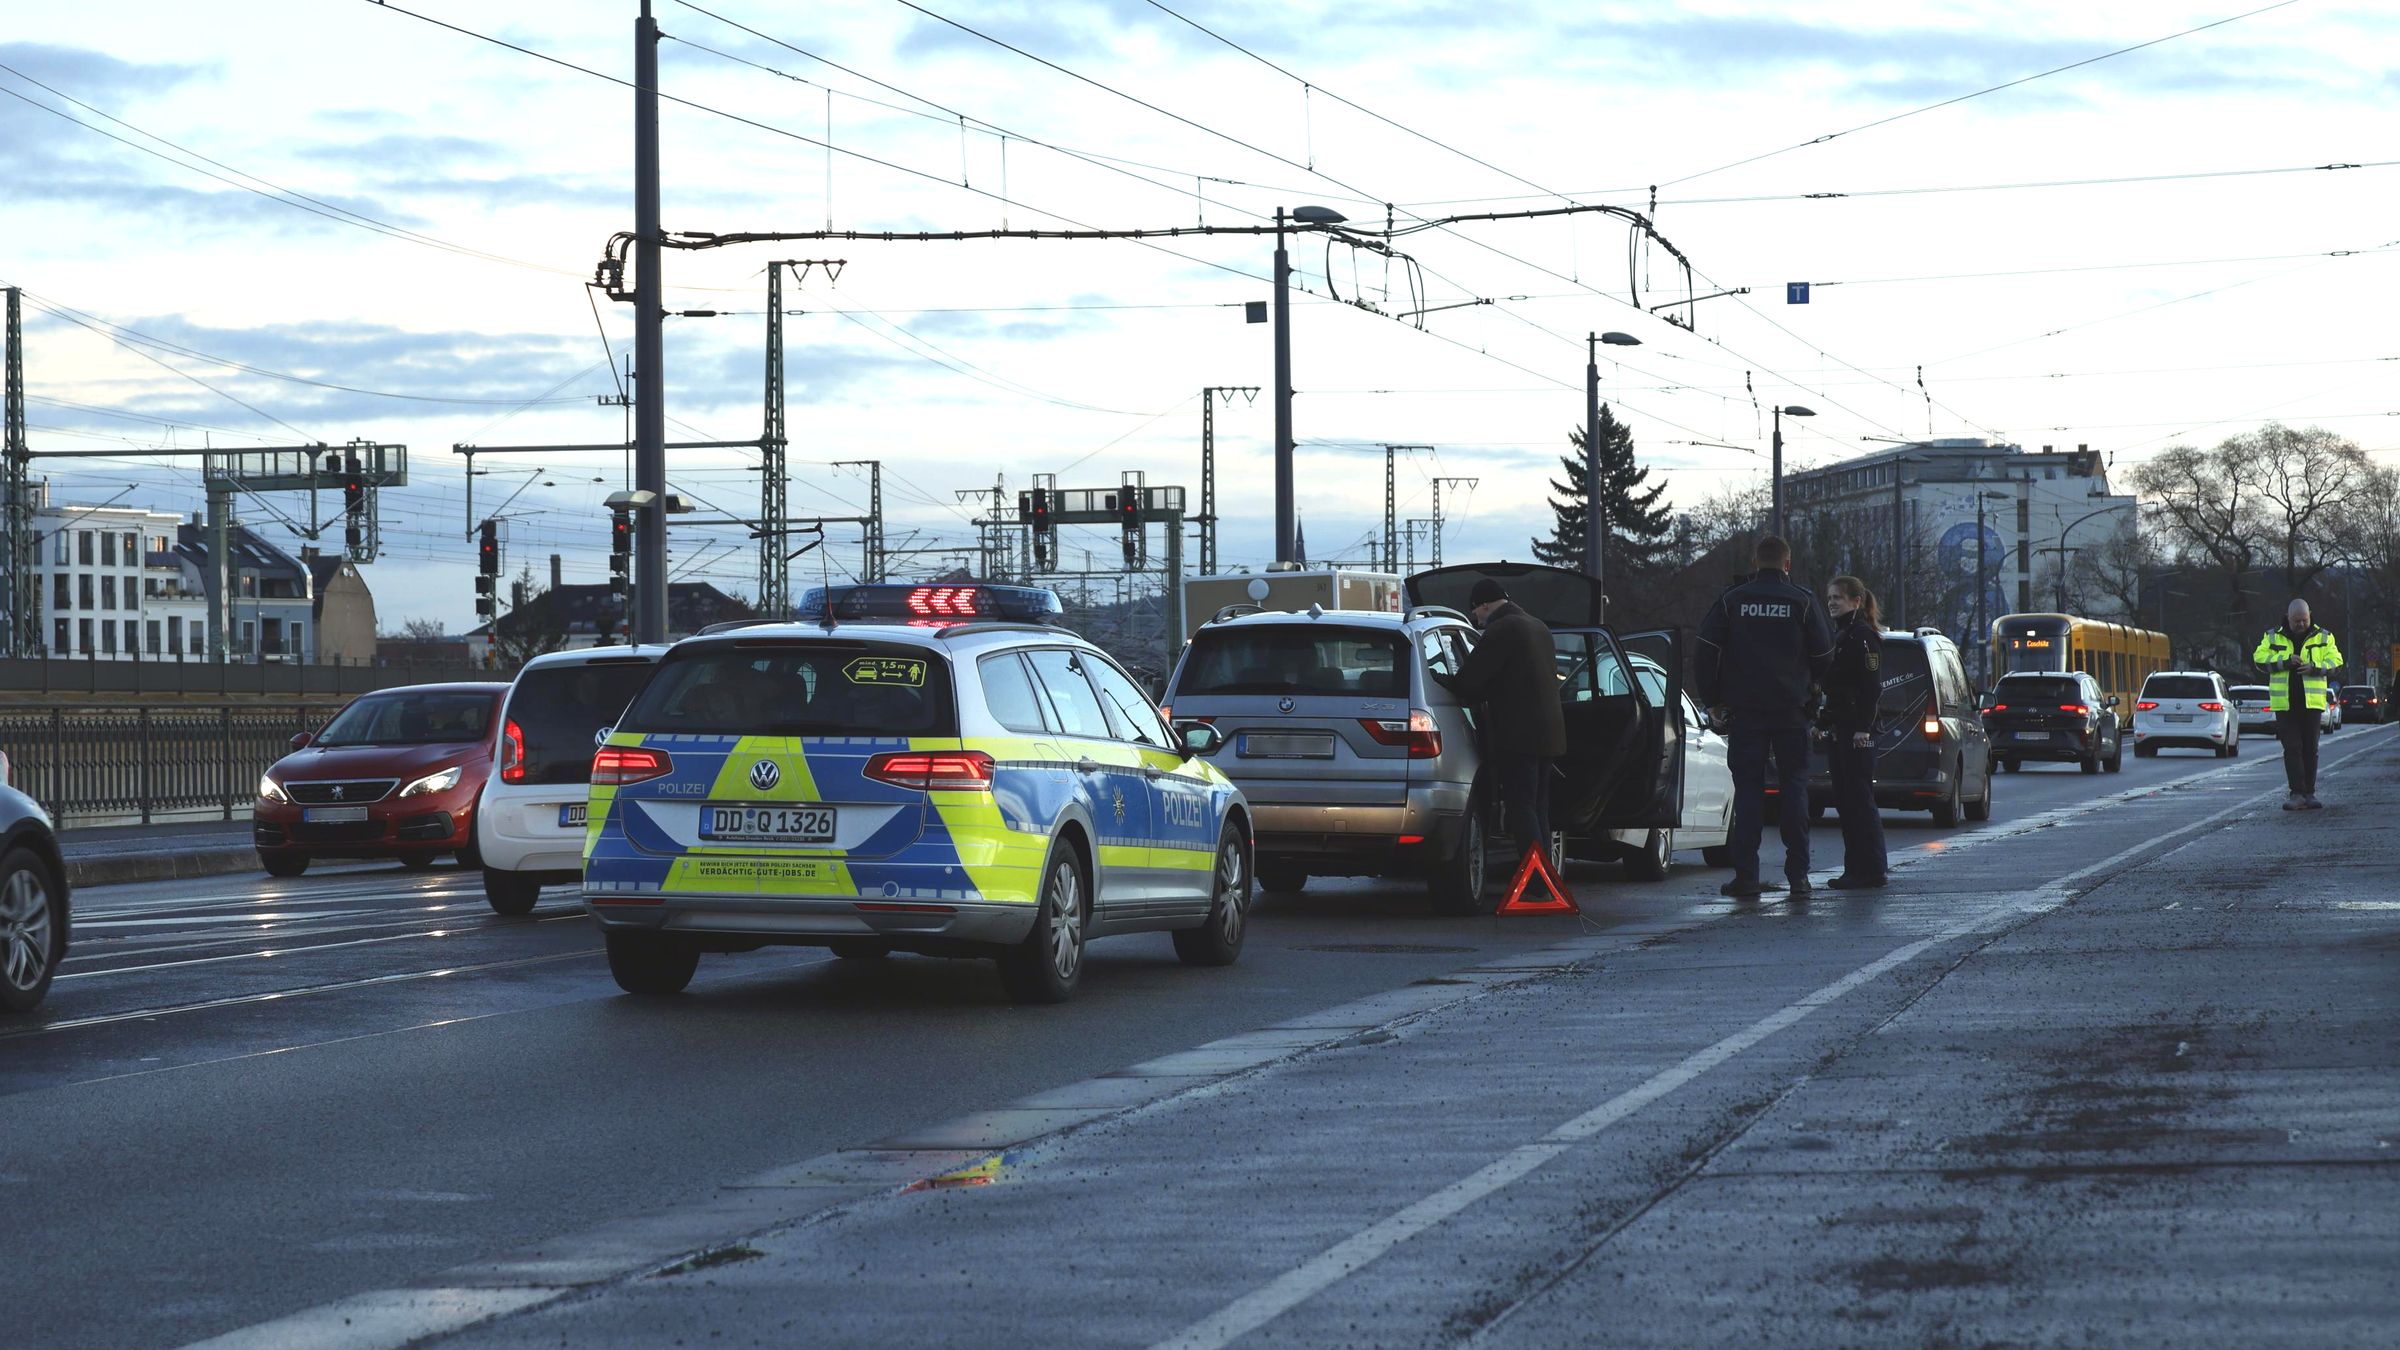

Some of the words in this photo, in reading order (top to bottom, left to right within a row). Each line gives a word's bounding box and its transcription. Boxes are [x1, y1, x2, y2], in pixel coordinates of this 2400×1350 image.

[1791, 286, 1804, 301] T
[1740, 603, 1790, 617] POLIZEI
[880, 661, 896, 669] 1,5
[658, 783, 705, 794] POLIZEI
[569, 807, 586, 821] DD
[1162, 791, 1202, 828] POLIZEI
[714, 810, 743, 832] DD
[758, 811, 771, 833] Q
[776, 811, 831, 834] 1326
[700, 867, 816, 878] VERDÄCHTIG-GUTE-JOBS.DE
